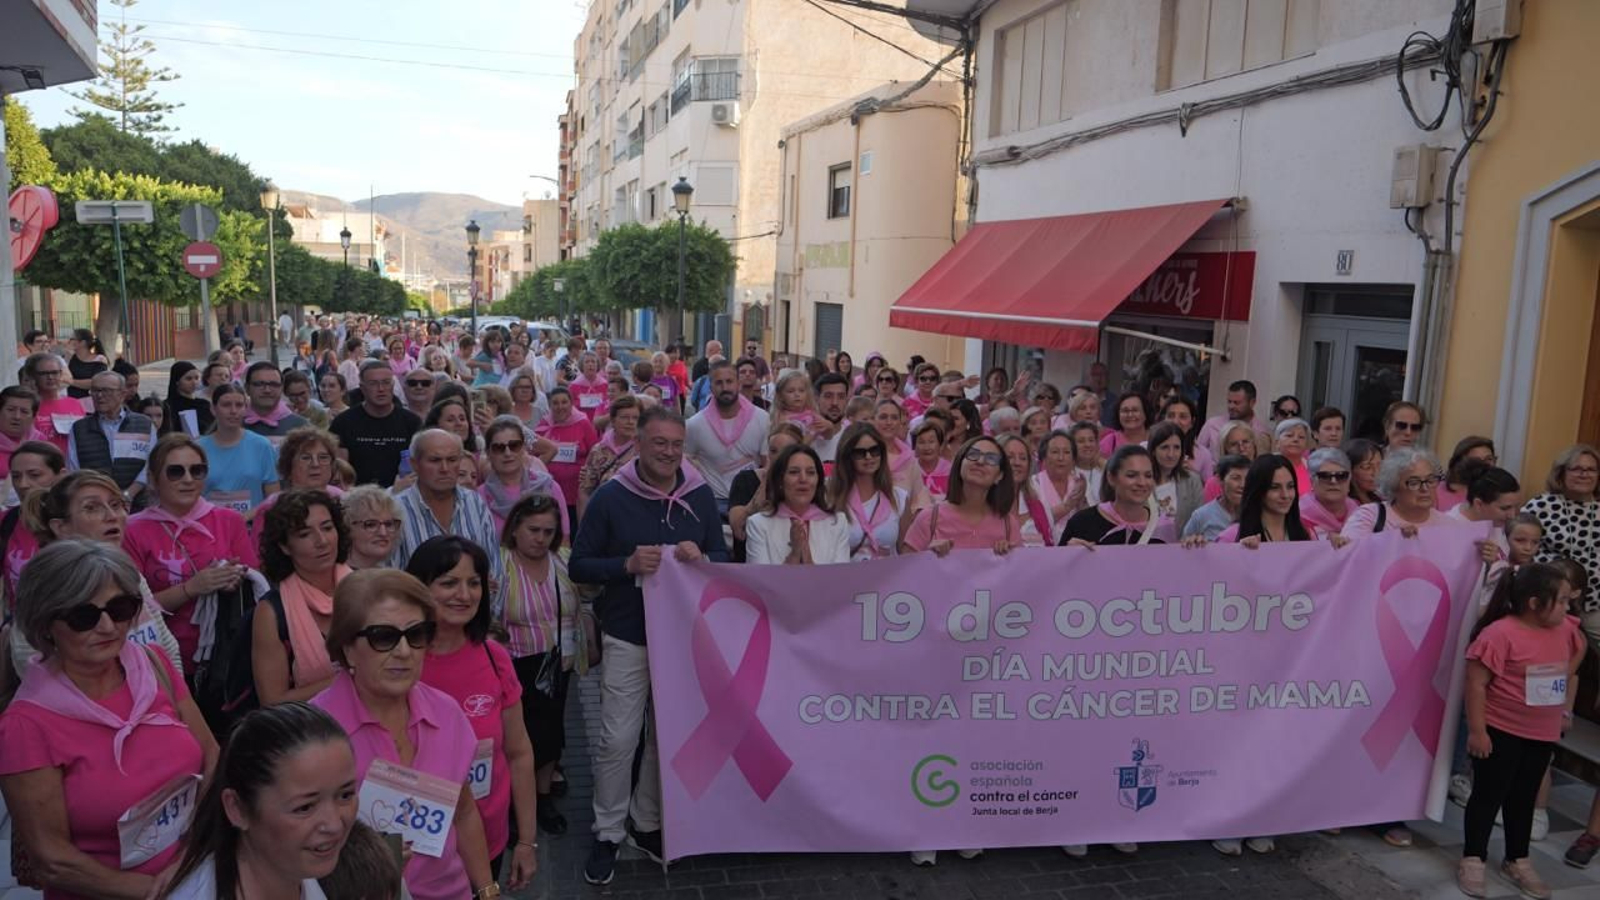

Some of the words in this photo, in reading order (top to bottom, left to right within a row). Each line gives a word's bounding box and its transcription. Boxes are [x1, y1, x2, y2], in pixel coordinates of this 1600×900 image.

[1336, 252, 1353, 271] 80
[852, 590, 926, 643] 19
[946, 590, 1033, 642] de
[1053, 581, 1315, 639] octubre
[962, 647, 1031, 682] DÍA
[1042, 649, 1214, 681] MUNDIAL
[798, 693, 960, 724] CONTRA
[970, 692, 1015, 720] EL
[1027, 686, 1179, 721] CÁNCER
[1190, 685, 1238, 712] DE
[1248, 679, 1371, 709] MAMA
[970, 760, 1044, 771] asociación
[970, 775, 1033, 788] española
[1178, 778, 1199, 788] Berja
[970, 791, 1015, 802] contra
[1018, 790, 1030, 802] el
[1033, 789, 1078, 801] cáncer
[395, 797, 445, 834] 283
[971, 807, 997, 817] Junta
[1000, 806, 1021, 816] local
[1023, 807, 1034, 816] de
[1036, 806, 1058, 817] Berja
